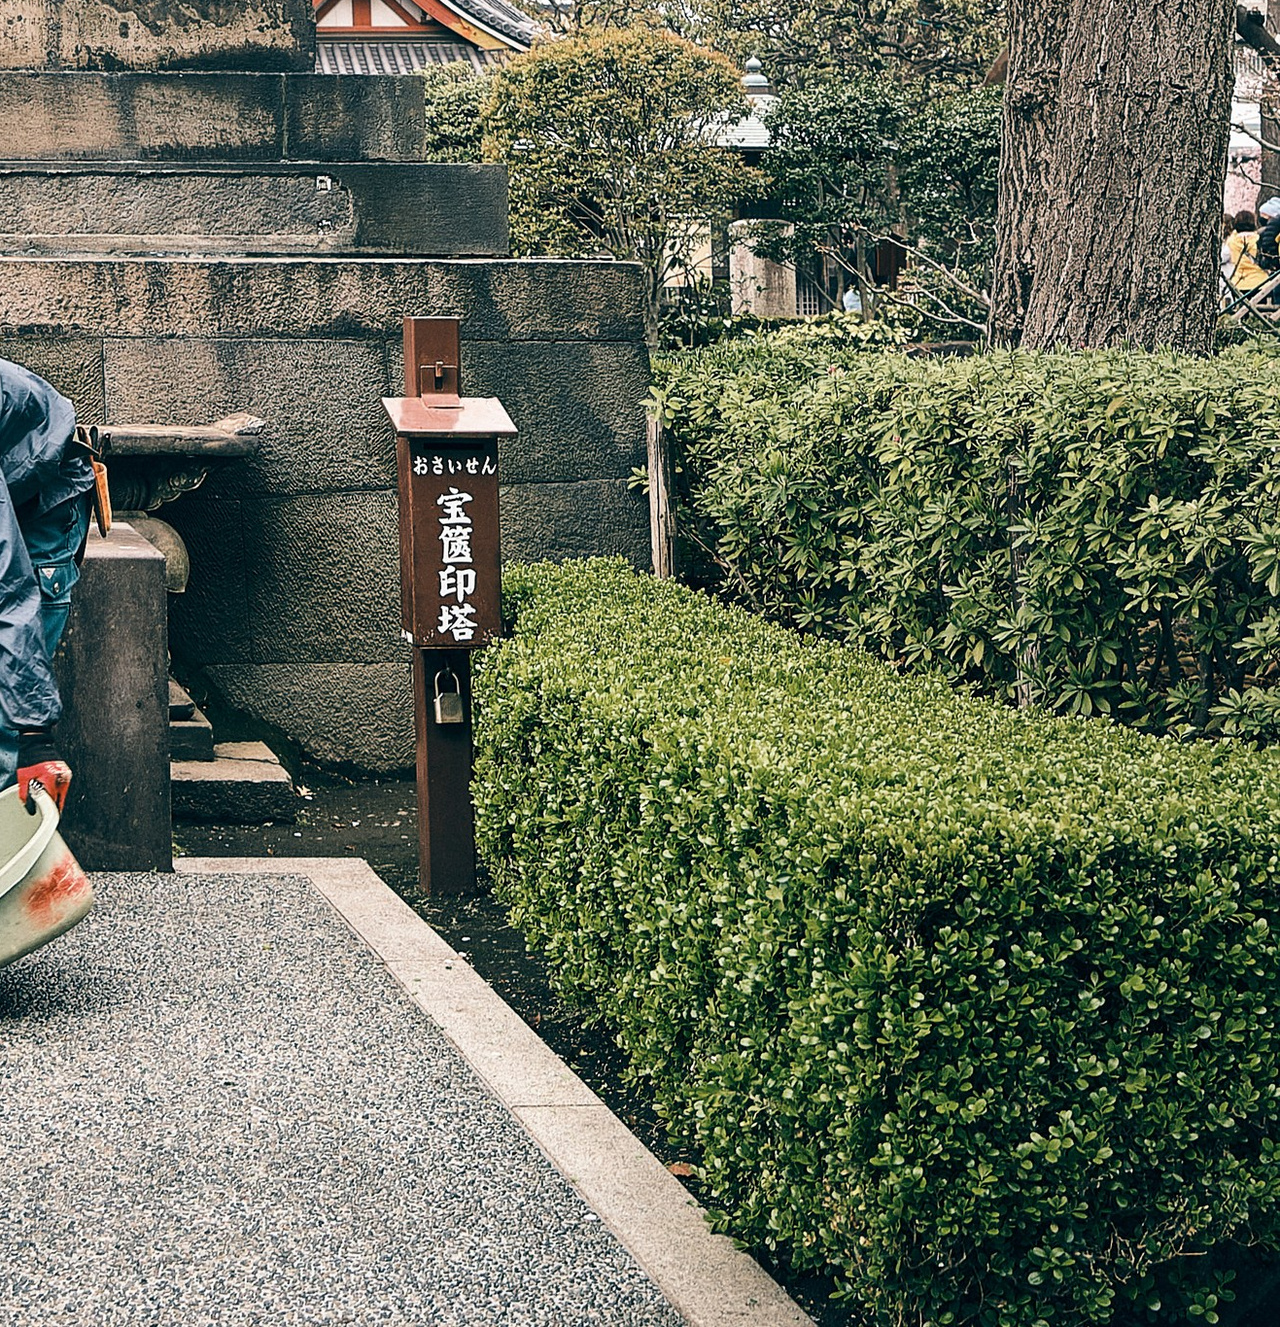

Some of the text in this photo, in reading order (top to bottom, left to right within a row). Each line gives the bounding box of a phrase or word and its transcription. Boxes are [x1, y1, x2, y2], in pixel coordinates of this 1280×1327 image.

[413, 455, 497, 476] おさいせん
[436, 486, 478, 642] 宝篋印塔
